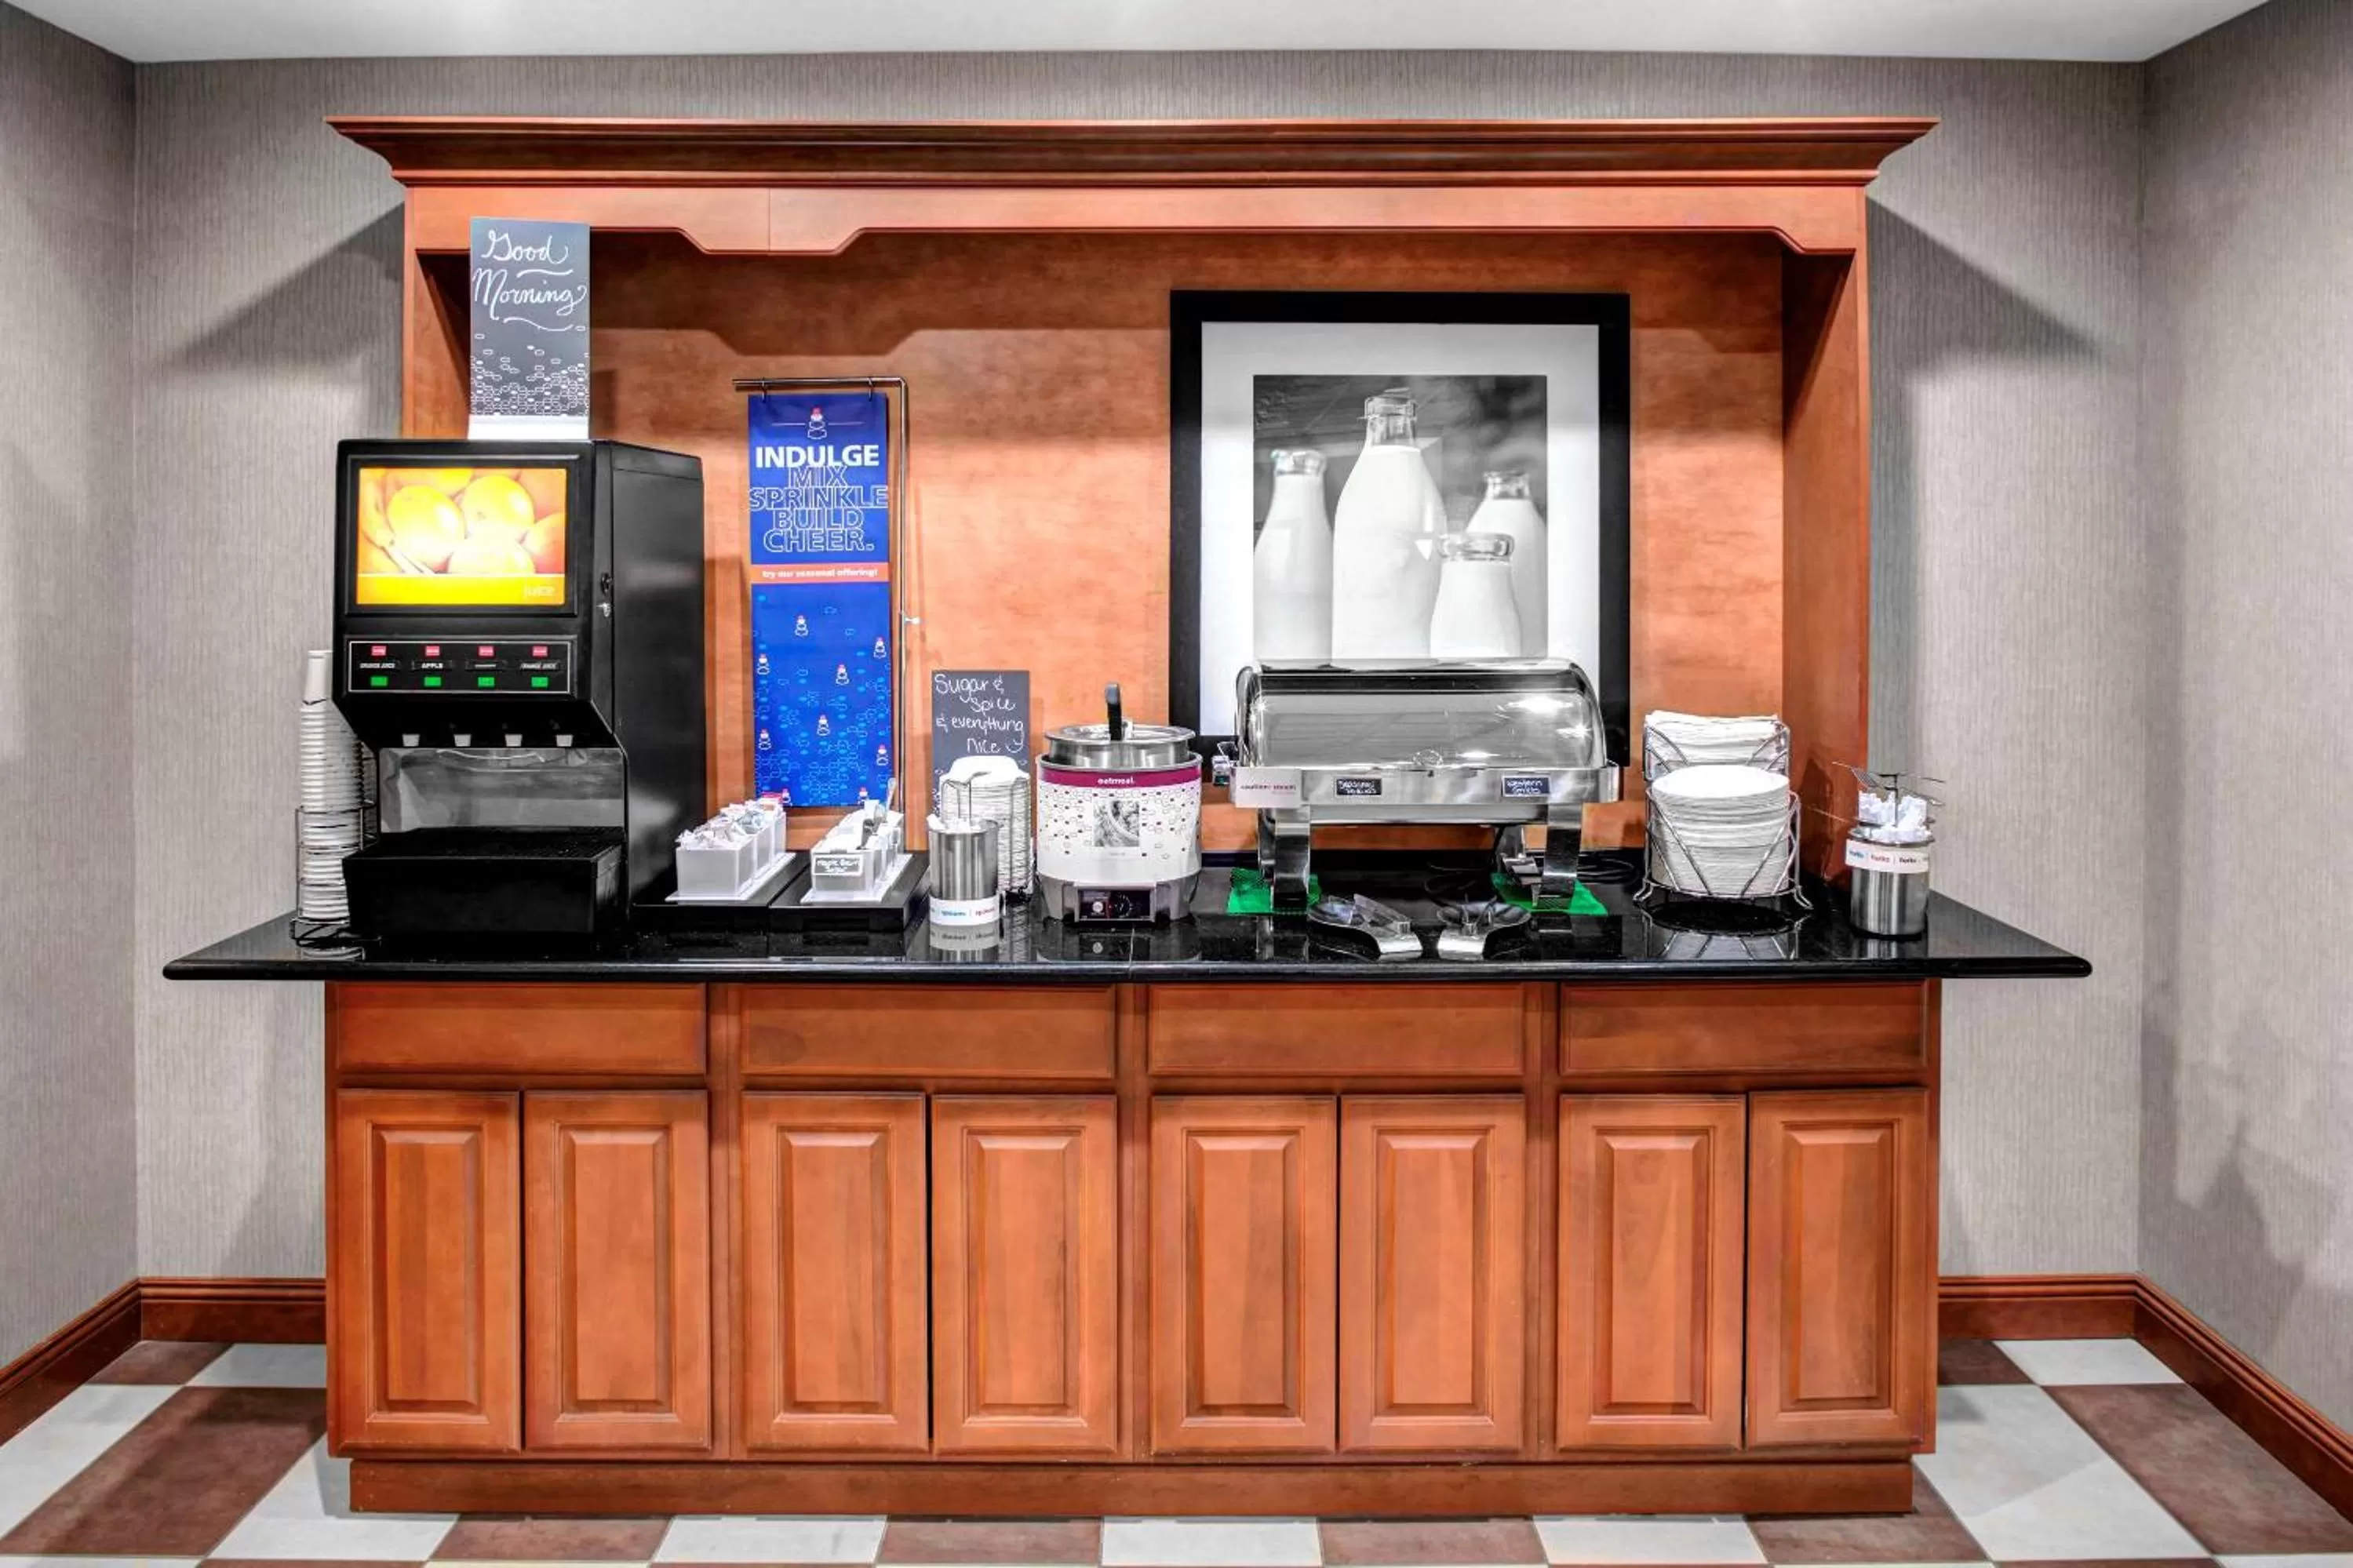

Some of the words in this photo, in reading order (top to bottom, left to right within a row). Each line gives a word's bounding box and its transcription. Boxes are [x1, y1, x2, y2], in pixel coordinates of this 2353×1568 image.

[480, 229, 569, 265] Good
[472, 267, 588, 321] Morning
[756, 444, 880, 468] INDULGE
[789, 464, 847, 487] MIX
[749, 485, 888, 511] SPRINKLE
[773, 508, 864, 530] BUILD
[763, 527, 875, 553] CHEER.
[934, 673, 989, 703] Sugar
